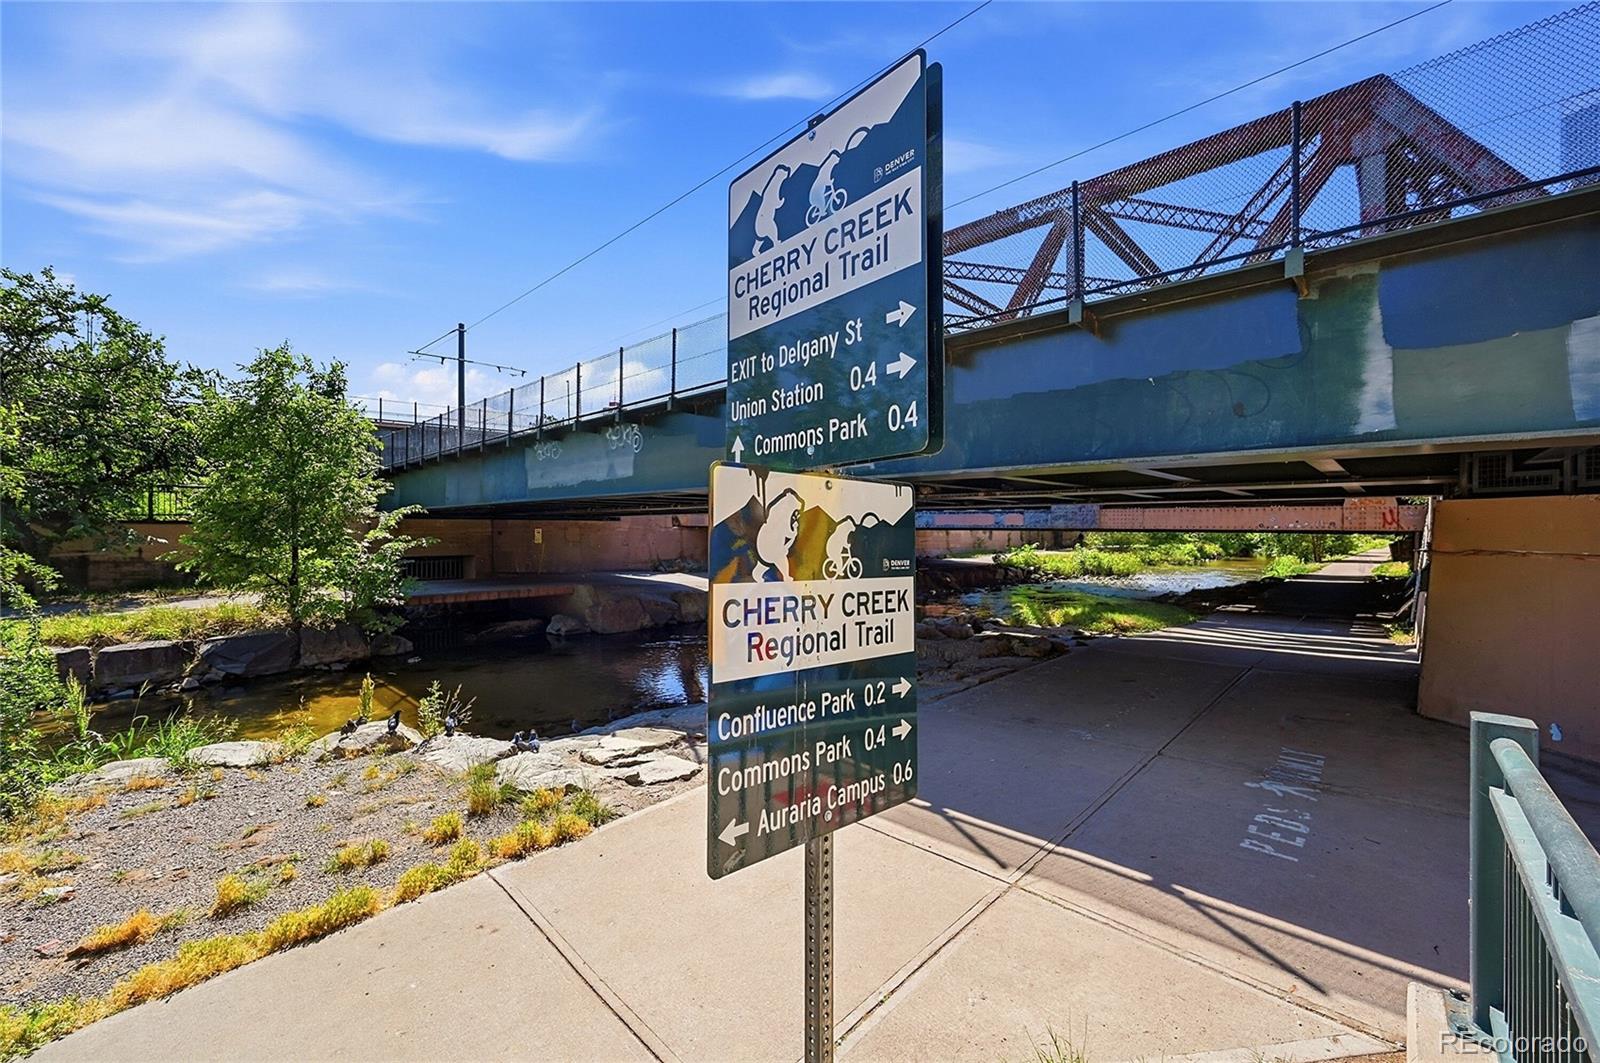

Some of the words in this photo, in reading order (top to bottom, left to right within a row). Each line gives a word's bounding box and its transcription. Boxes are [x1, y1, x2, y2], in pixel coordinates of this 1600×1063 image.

[885, 149, 915, 171] DENVER
[734, 237, 818, 299] CHERRY
[824, 186, 914, 255] CREEK
[749, 262, 830, 319] Regional
[839, 232, 889, 280] Trail
[731, 355, 757, 384] EXIT
[761, 352, 775, 374] to
[779, 331, 840, 368] Delgany
[845, 317, 863, 346] St
[731, 399, 767, 422] Union
[771, 382, 824, 412] Station
[850, 361, 877, 392] 0.4
[754, 428, 824, 457] Commons
[829, 413, 868, 443] Park
[888, 400, 919, 432] 0.4
[722, 593, 836, 629] CHERRY
[841, 589, 909, 618] CREEK
[747, 623, 847, 667] Regional
[855, 618, 894, 648] Trail
[718, 700, 816, 741] Confluence
[821, 688, 855, 717] Park
[864, 681, 886, 707] 0.2
[718, 751, 810, 796] Commons
[816, 734, 852, 767] Park
[864, 724, 886, 751] 0.4
[757, 793, 821, 837] Auraria
[827, 773, 886, 810] Campus
[893, 759, 913, 785] 0.6
